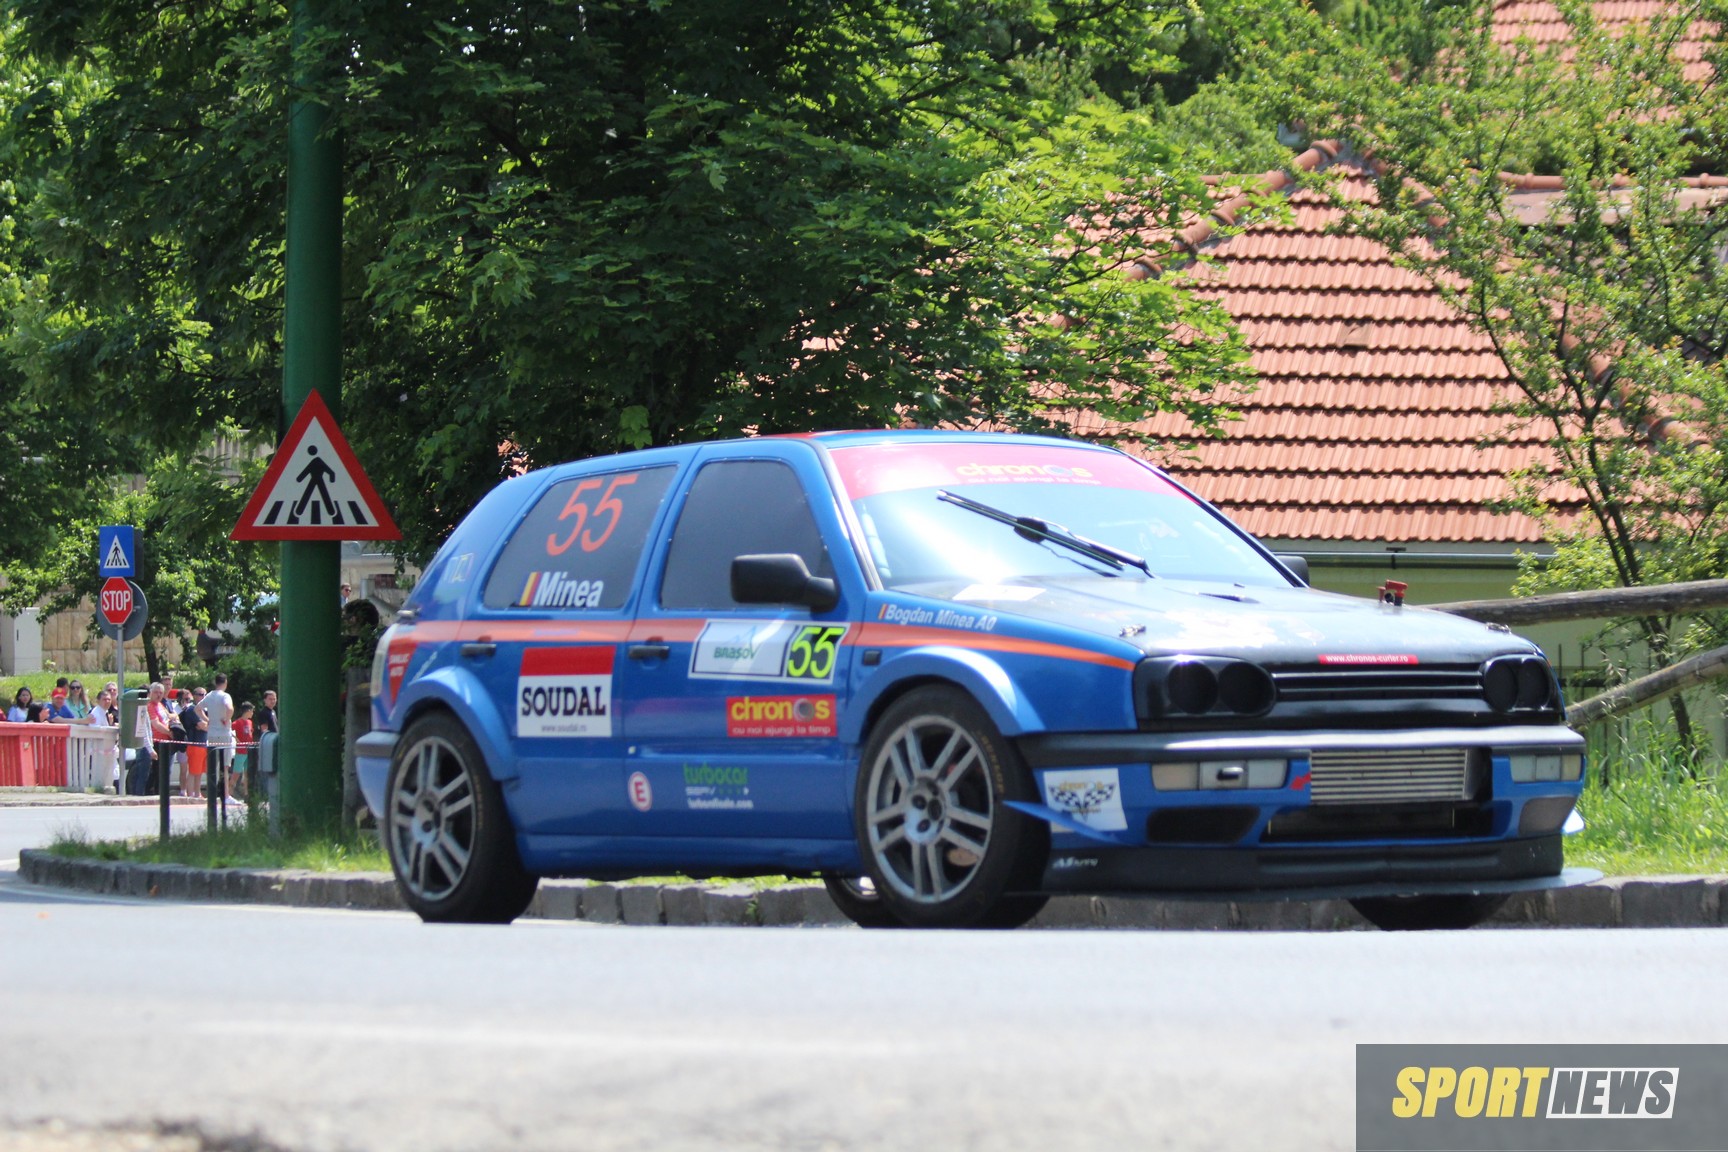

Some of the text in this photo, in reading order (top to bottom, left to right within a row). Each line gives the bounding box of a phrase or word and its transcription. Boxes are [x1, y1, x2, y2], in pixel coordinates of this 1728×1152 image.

[546, 474, 639, 556] 55
[102, 590, 131, 611] STOP
[533, 572, 604, 607] Minea
[885, 604, 934, 625] Bogdan
[935, 609, 975, 628] Minea
[787, 627, 846, 678] 55
[522, 686, 606, 716] SOUDAL
[731, 696, 830, 722] chronos
[634, 781, 647, 802] E
